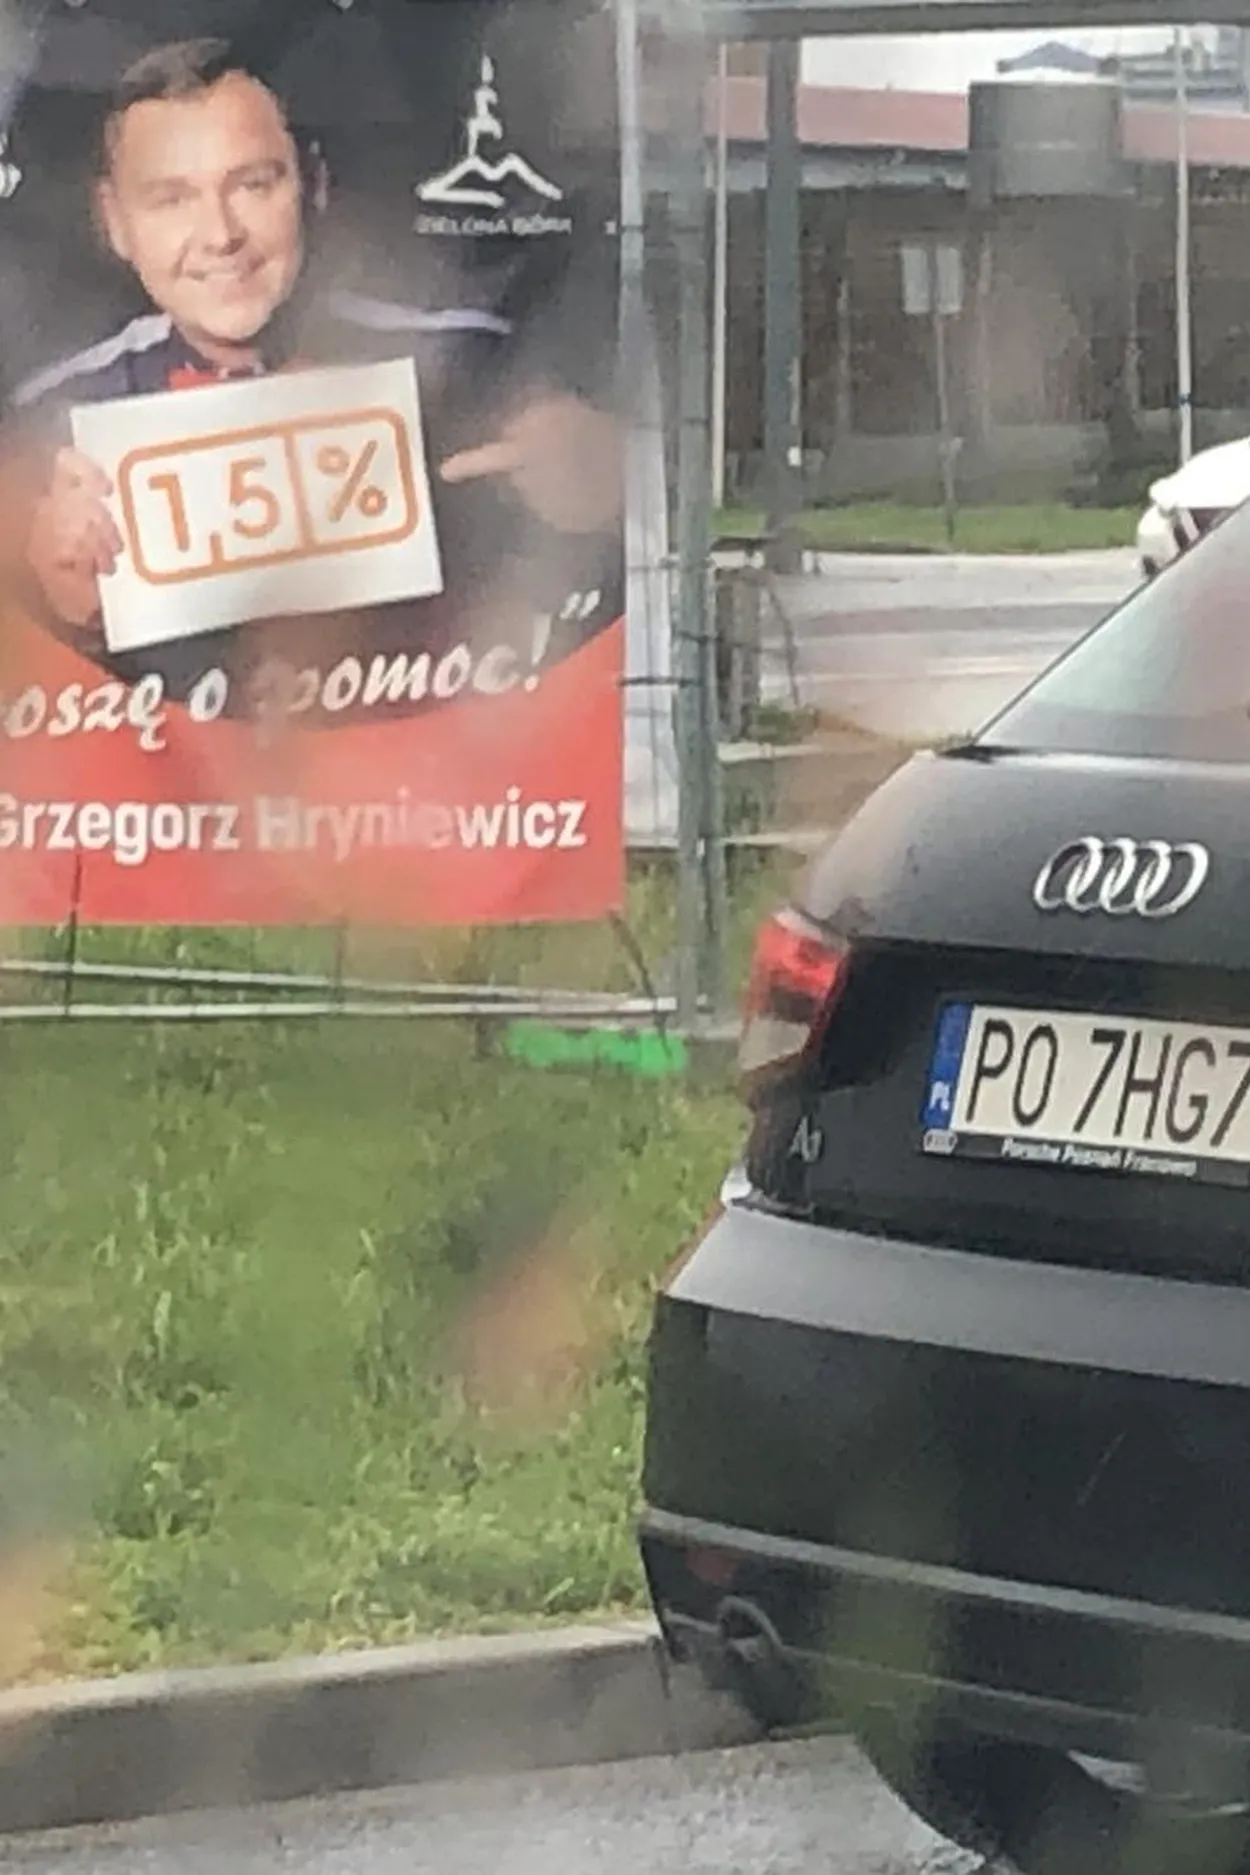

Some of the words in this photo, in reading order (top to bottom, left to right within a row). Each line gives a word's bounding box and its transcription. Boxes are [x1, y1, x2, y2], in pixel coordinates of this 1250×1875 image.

[0, 673, 167, 752] oszę
[188, 668, 229, 722] o
[253, 785, 588, 861] Hryniewicz
[965, 1018, 1058, 1127] PO
